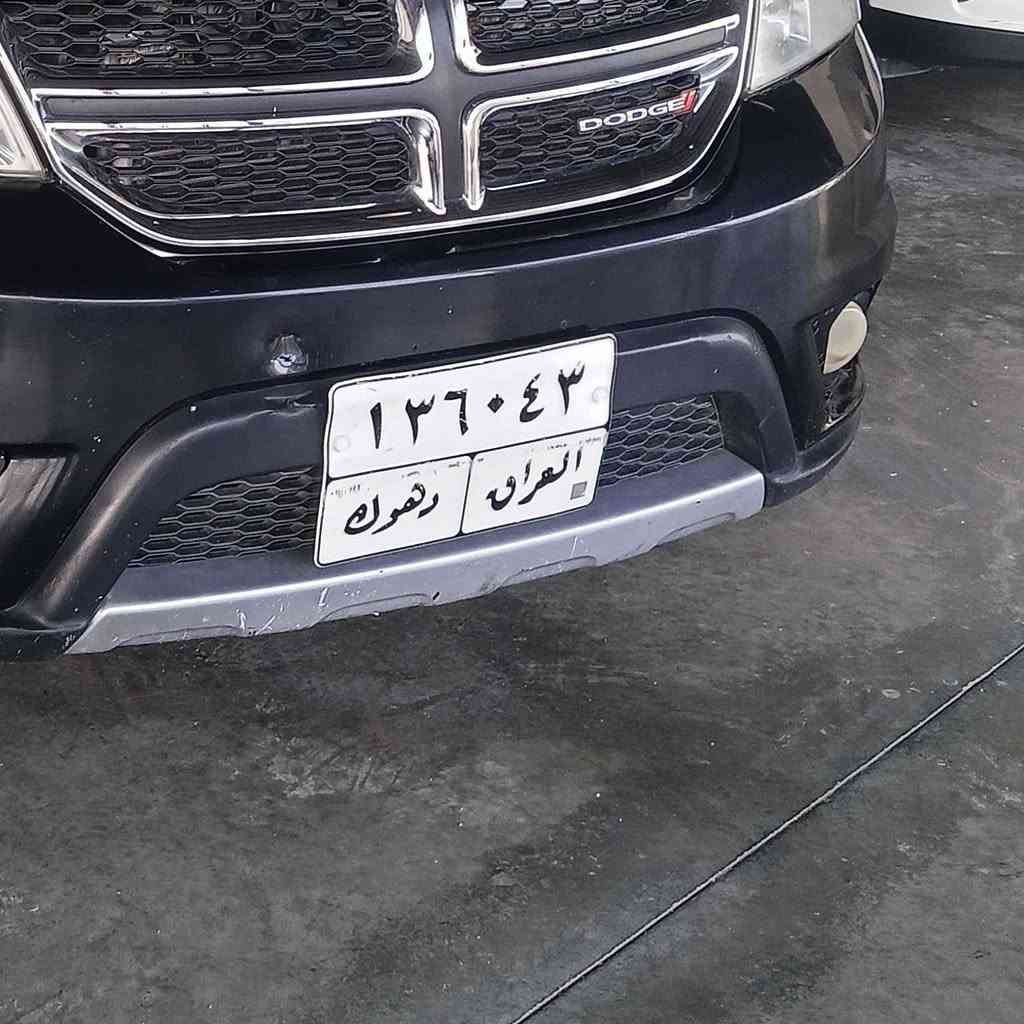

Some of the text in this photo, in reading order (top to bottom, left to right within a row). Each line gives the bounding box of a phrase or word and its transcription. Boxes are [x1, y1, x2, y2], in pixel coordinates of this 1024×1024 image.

[579, 96, 686, 132] DODGE
[370, 361, 585, 449] ١٣٦٠٤٣
[343, 482, 440, 536] دهوك
[487, 449, 582, 511] العراق
